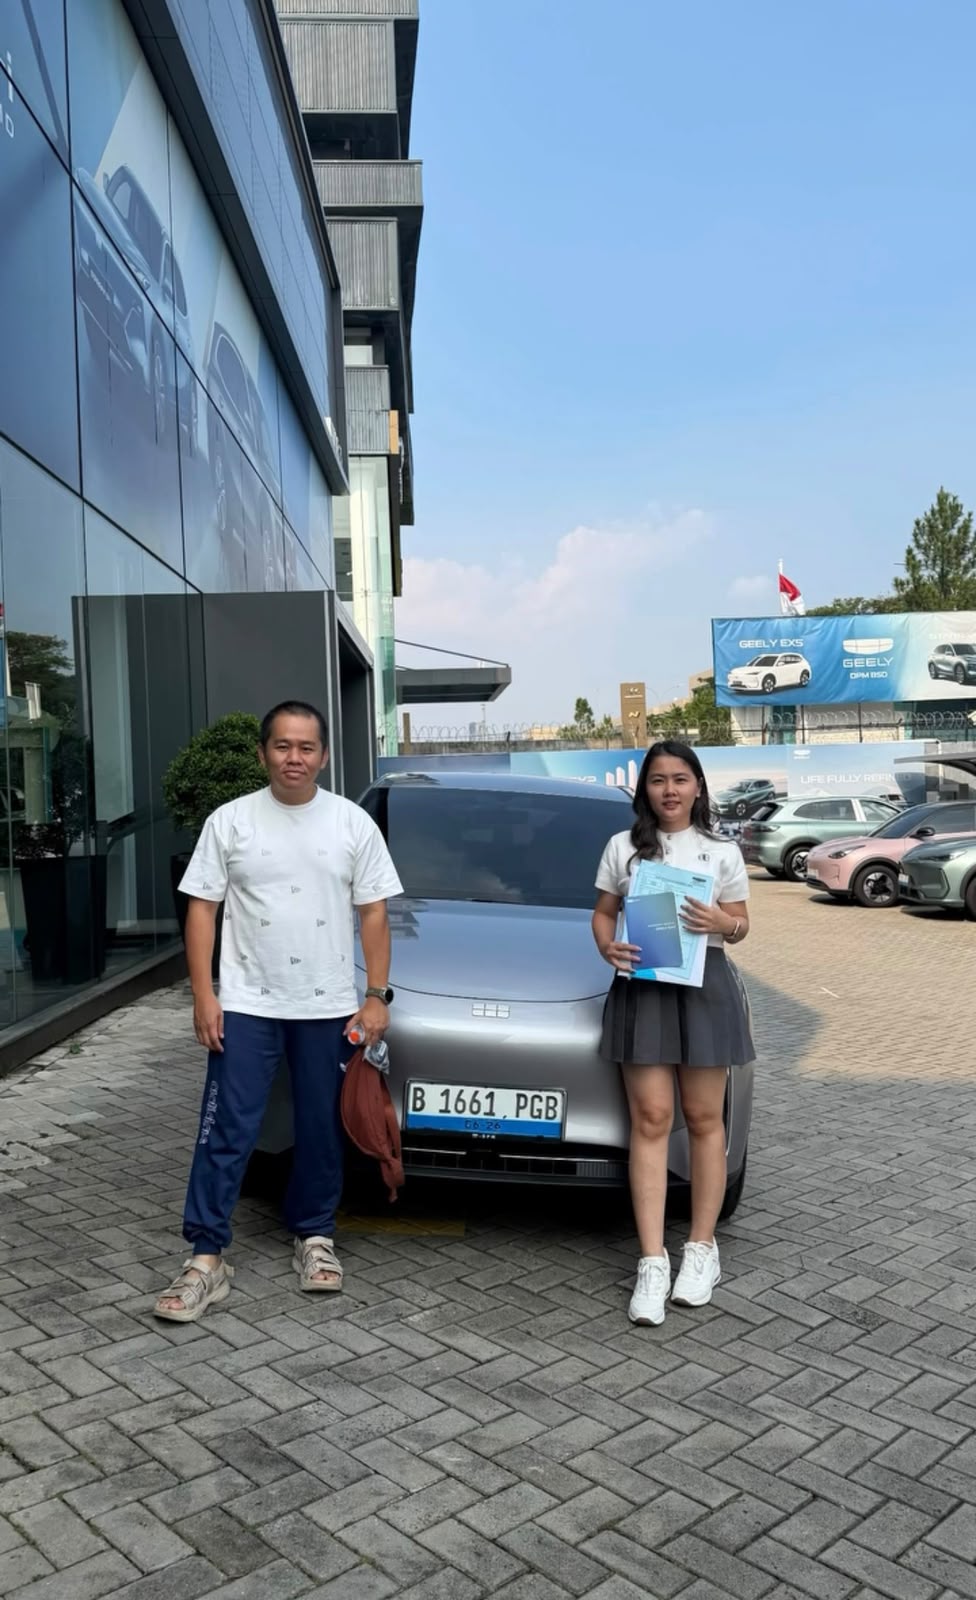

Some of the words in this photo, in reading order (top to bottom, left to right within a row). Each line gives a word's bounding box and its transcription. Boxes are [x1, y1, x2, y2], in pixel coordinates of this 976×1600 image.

[739, 639, 778, 649] GEELY
[780, 638, 804, 648] EX5
[843, 657, 894, 668] GEELY
[800, 775, 825, 784] LIFE
[827, 774, 862, 784] FULLY
[412, 1087, 426, 1112] B
[438, 1088, 496, 1117] 1661
[515, 1092, 558, 1121] PGB
